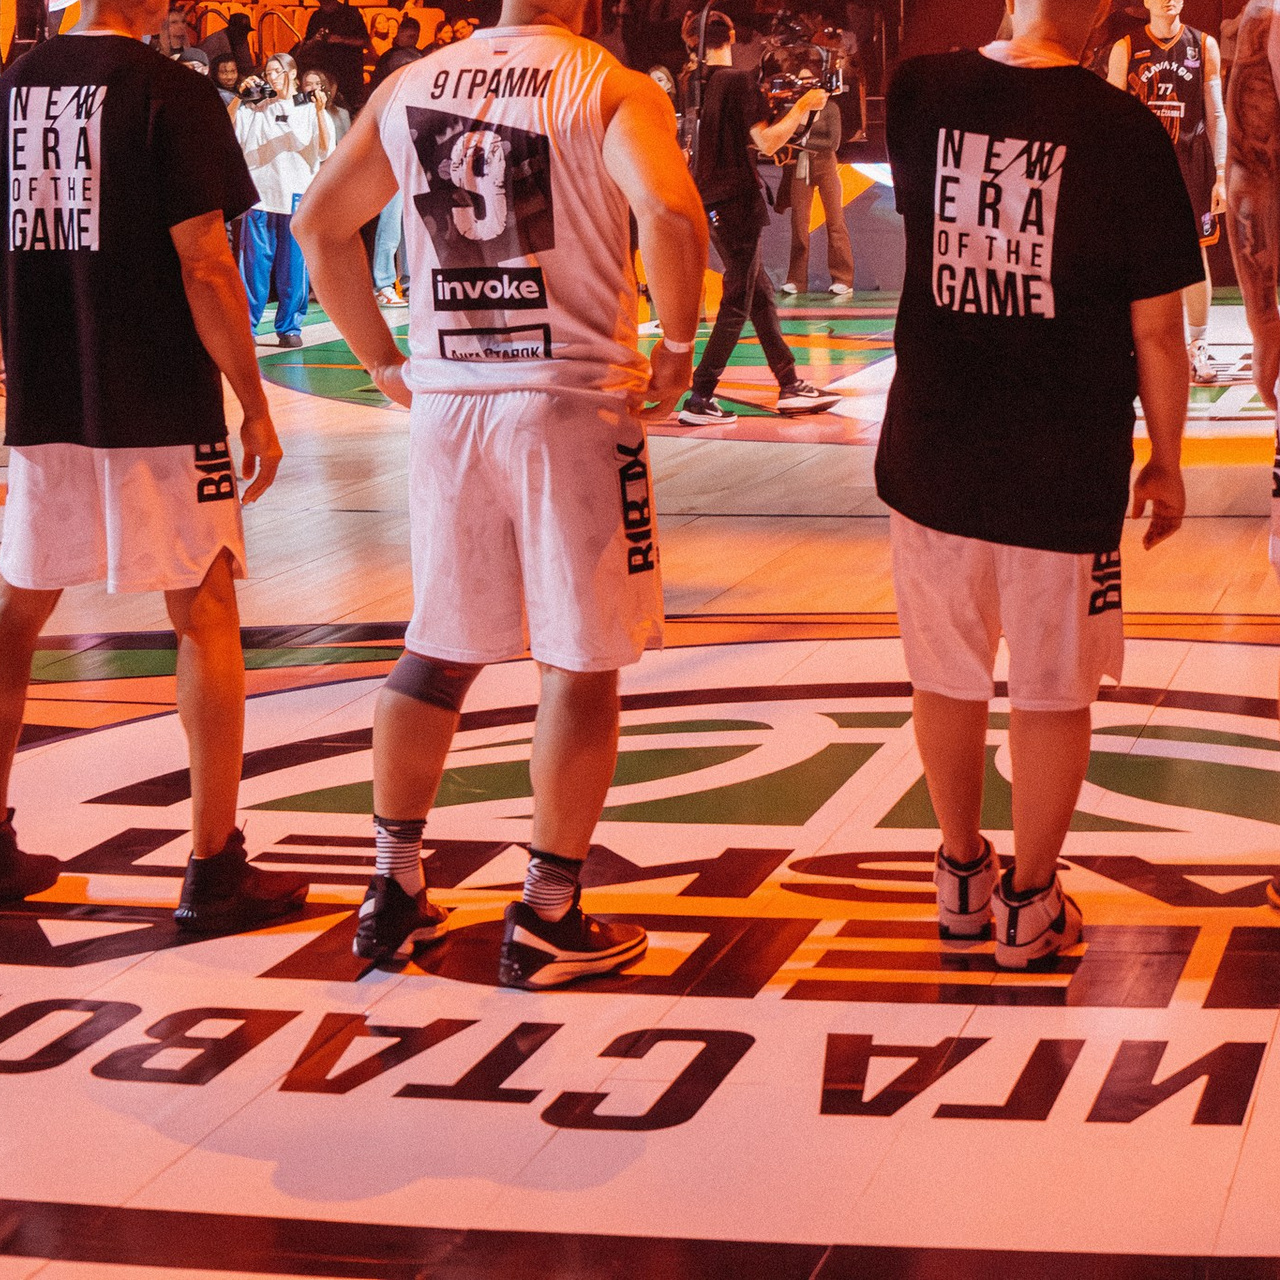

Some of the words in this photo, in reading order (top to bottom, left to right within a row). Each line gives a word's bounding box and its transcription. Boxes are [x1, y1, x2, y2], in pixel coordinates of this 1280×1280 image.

[430, 70, 450, 100] 9
[452, 67, 553, 99] ГРАММ
[1158, 83, 1173, 95] 77
[13, 86, 102, 123] NEW
[13, 126, 92, 171] ERA
[942, 129, 1060, 181] NEW
[12, 177, 38, 202] OF
[50, 177, 92, 202] THE
[450, 129, 508, 241] 9
[939, 174, 1045, 236] ERA
[12, 207, 92, 251] GAME
[938, 230, 970, 259] OF
[985, 235, 1044, 268] THE
[436, 274, 540, 301] invoke
[937, 263, 1045, 318] GAME
